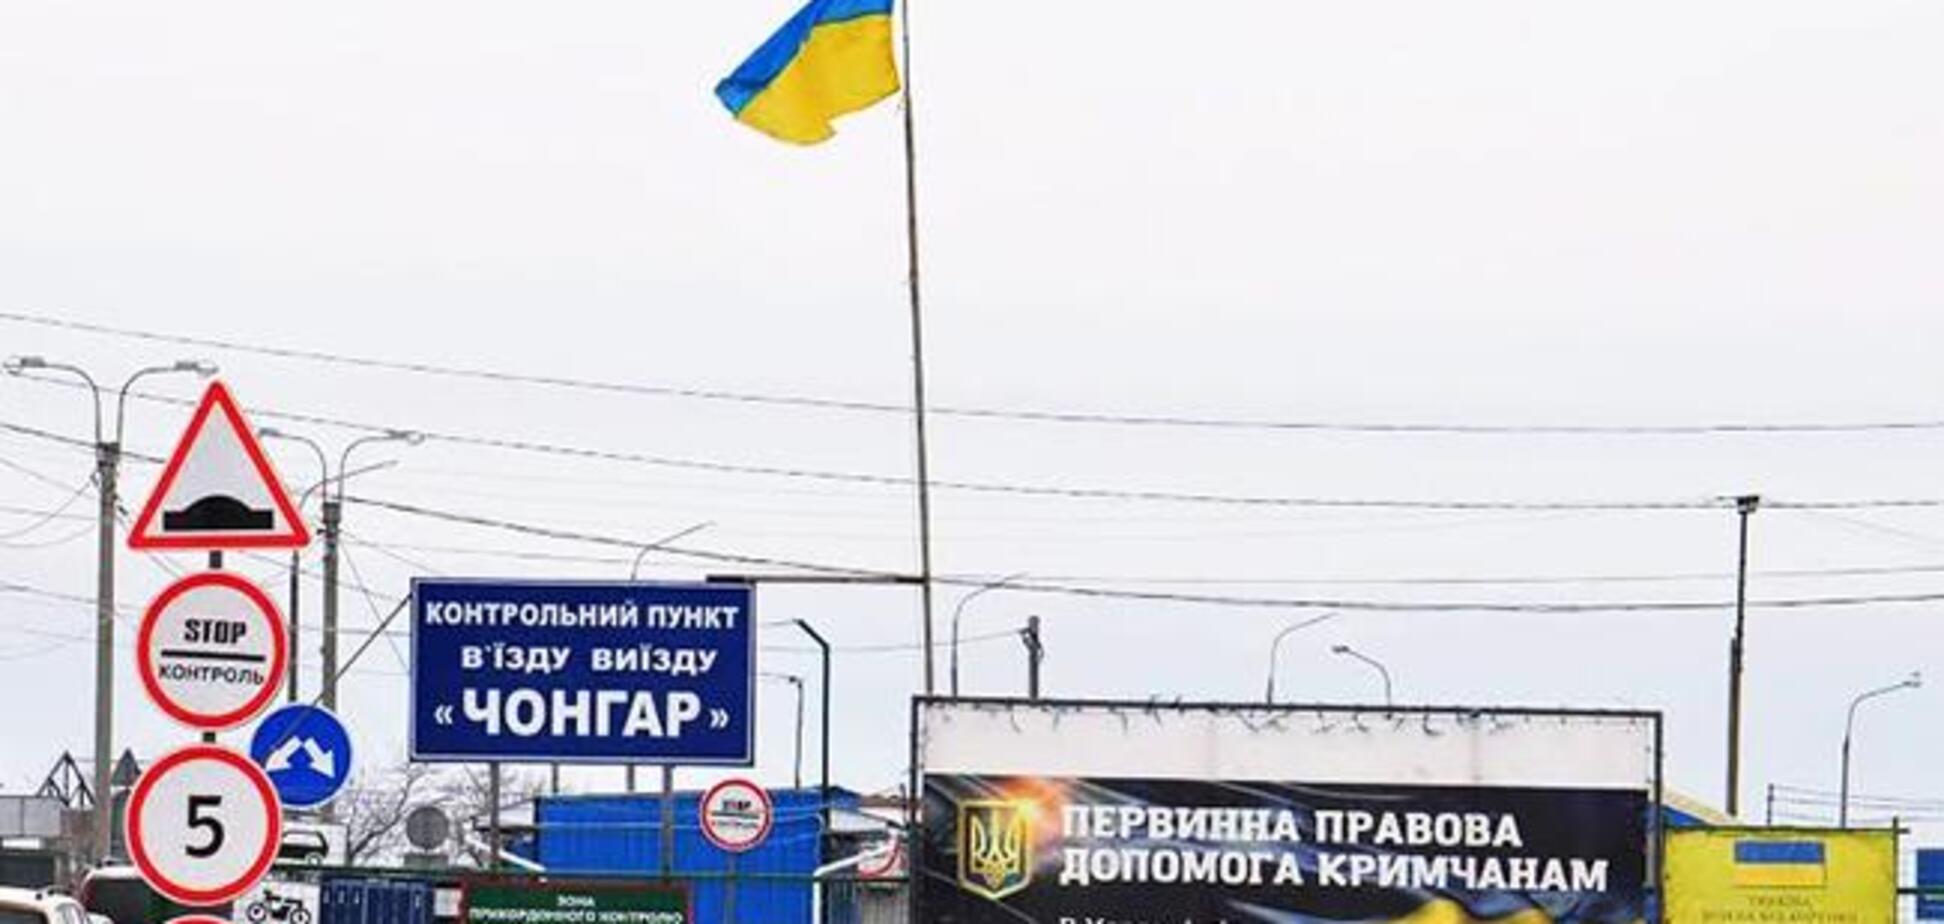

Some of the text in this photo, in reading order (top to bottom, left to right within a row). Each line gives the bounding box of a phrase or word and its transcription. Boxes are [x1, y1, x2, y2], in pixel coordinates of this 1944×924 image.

[184, 618, 246, 644] STOP
[426, 600, 740, 629] КОНТРОЛЬНИЙ ПУНКТ
[159, 663, 264, 685] КОНТРОЛЬ
[591, 643, 718, 676] ВИЇЗДУ
[185, 794, 226, 858] 5
[1060, 804, 1524, 848] ПЕРВИННА ПРАВОВА
[1058, 847, 1610, 892] ДОПОМОГА КРИМЧАНАМ
